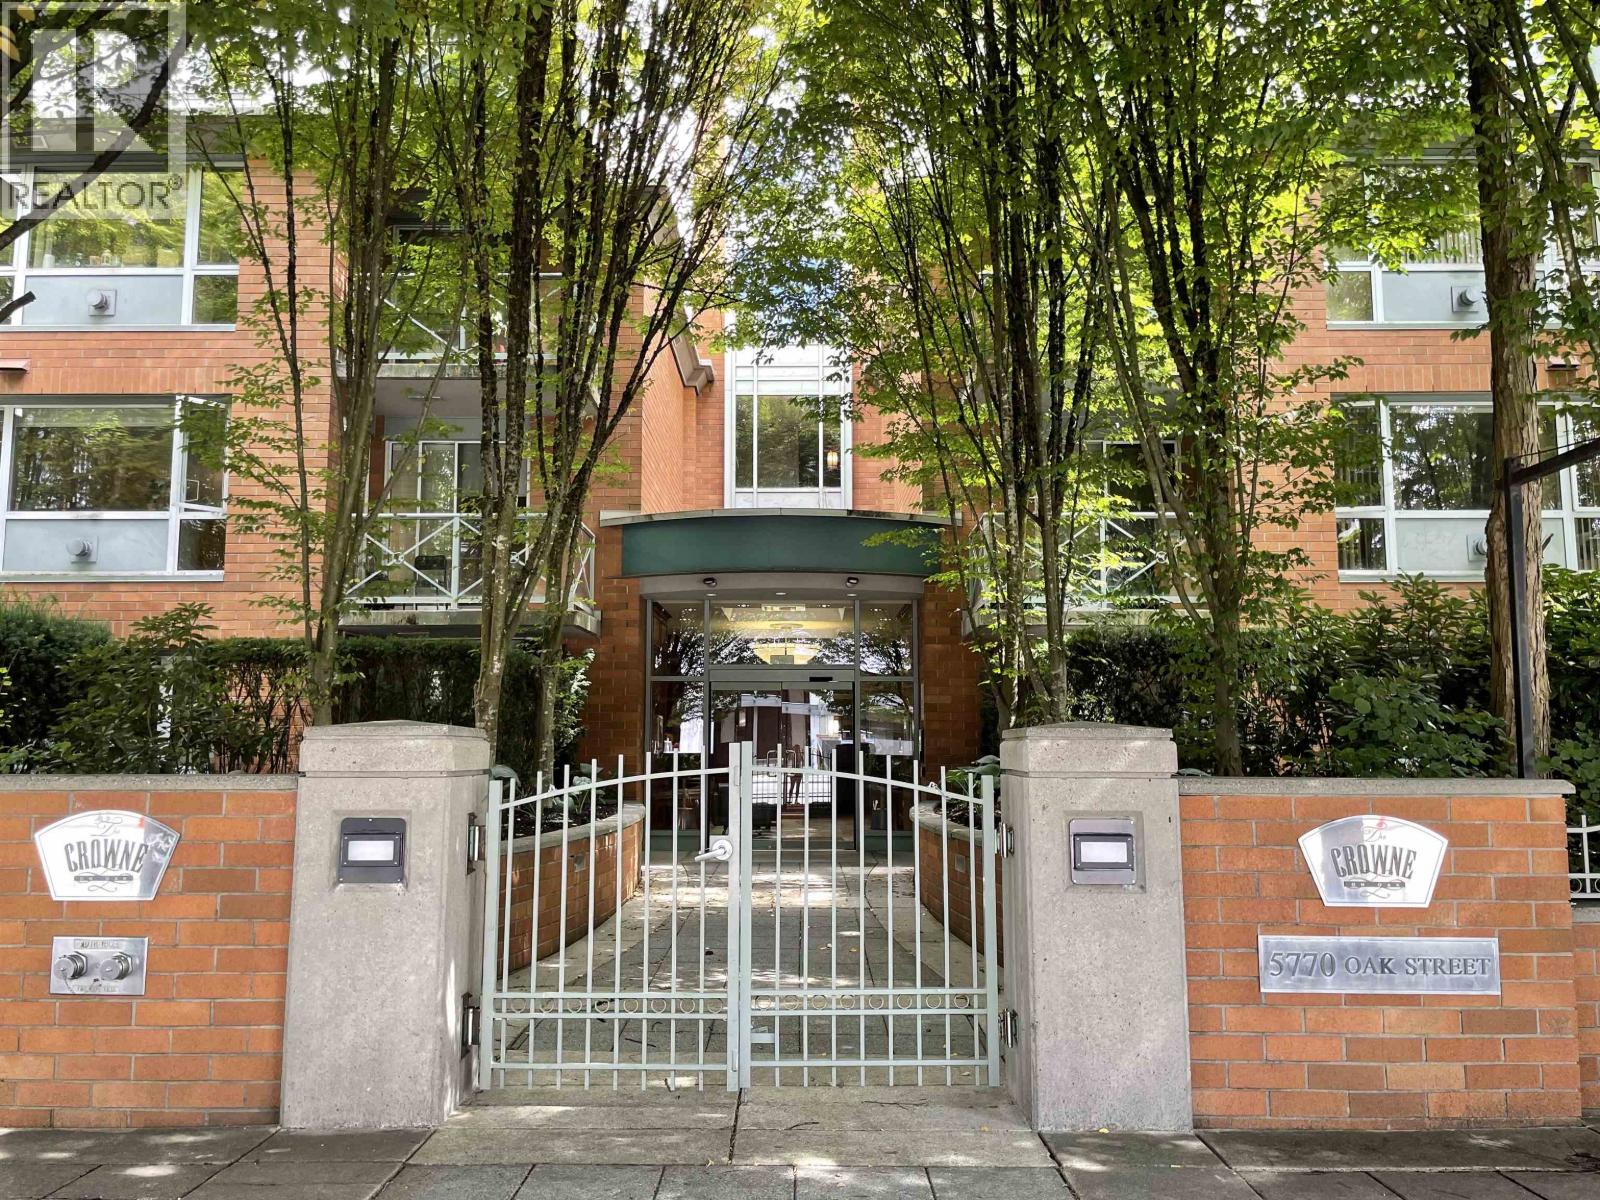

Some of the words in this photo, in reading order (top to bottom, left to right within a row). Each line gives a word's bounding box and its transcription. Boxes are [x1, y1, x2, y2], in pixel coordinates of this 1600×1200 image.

[64, 838, 149, 873] CROWNE
[1330, 844, 1417, 880] CROWNE
[1270, 952, 1336, 978] 5770
[1344, 957, 1397, 975] OAK
[1405, 957, 1491, 976] STREET
